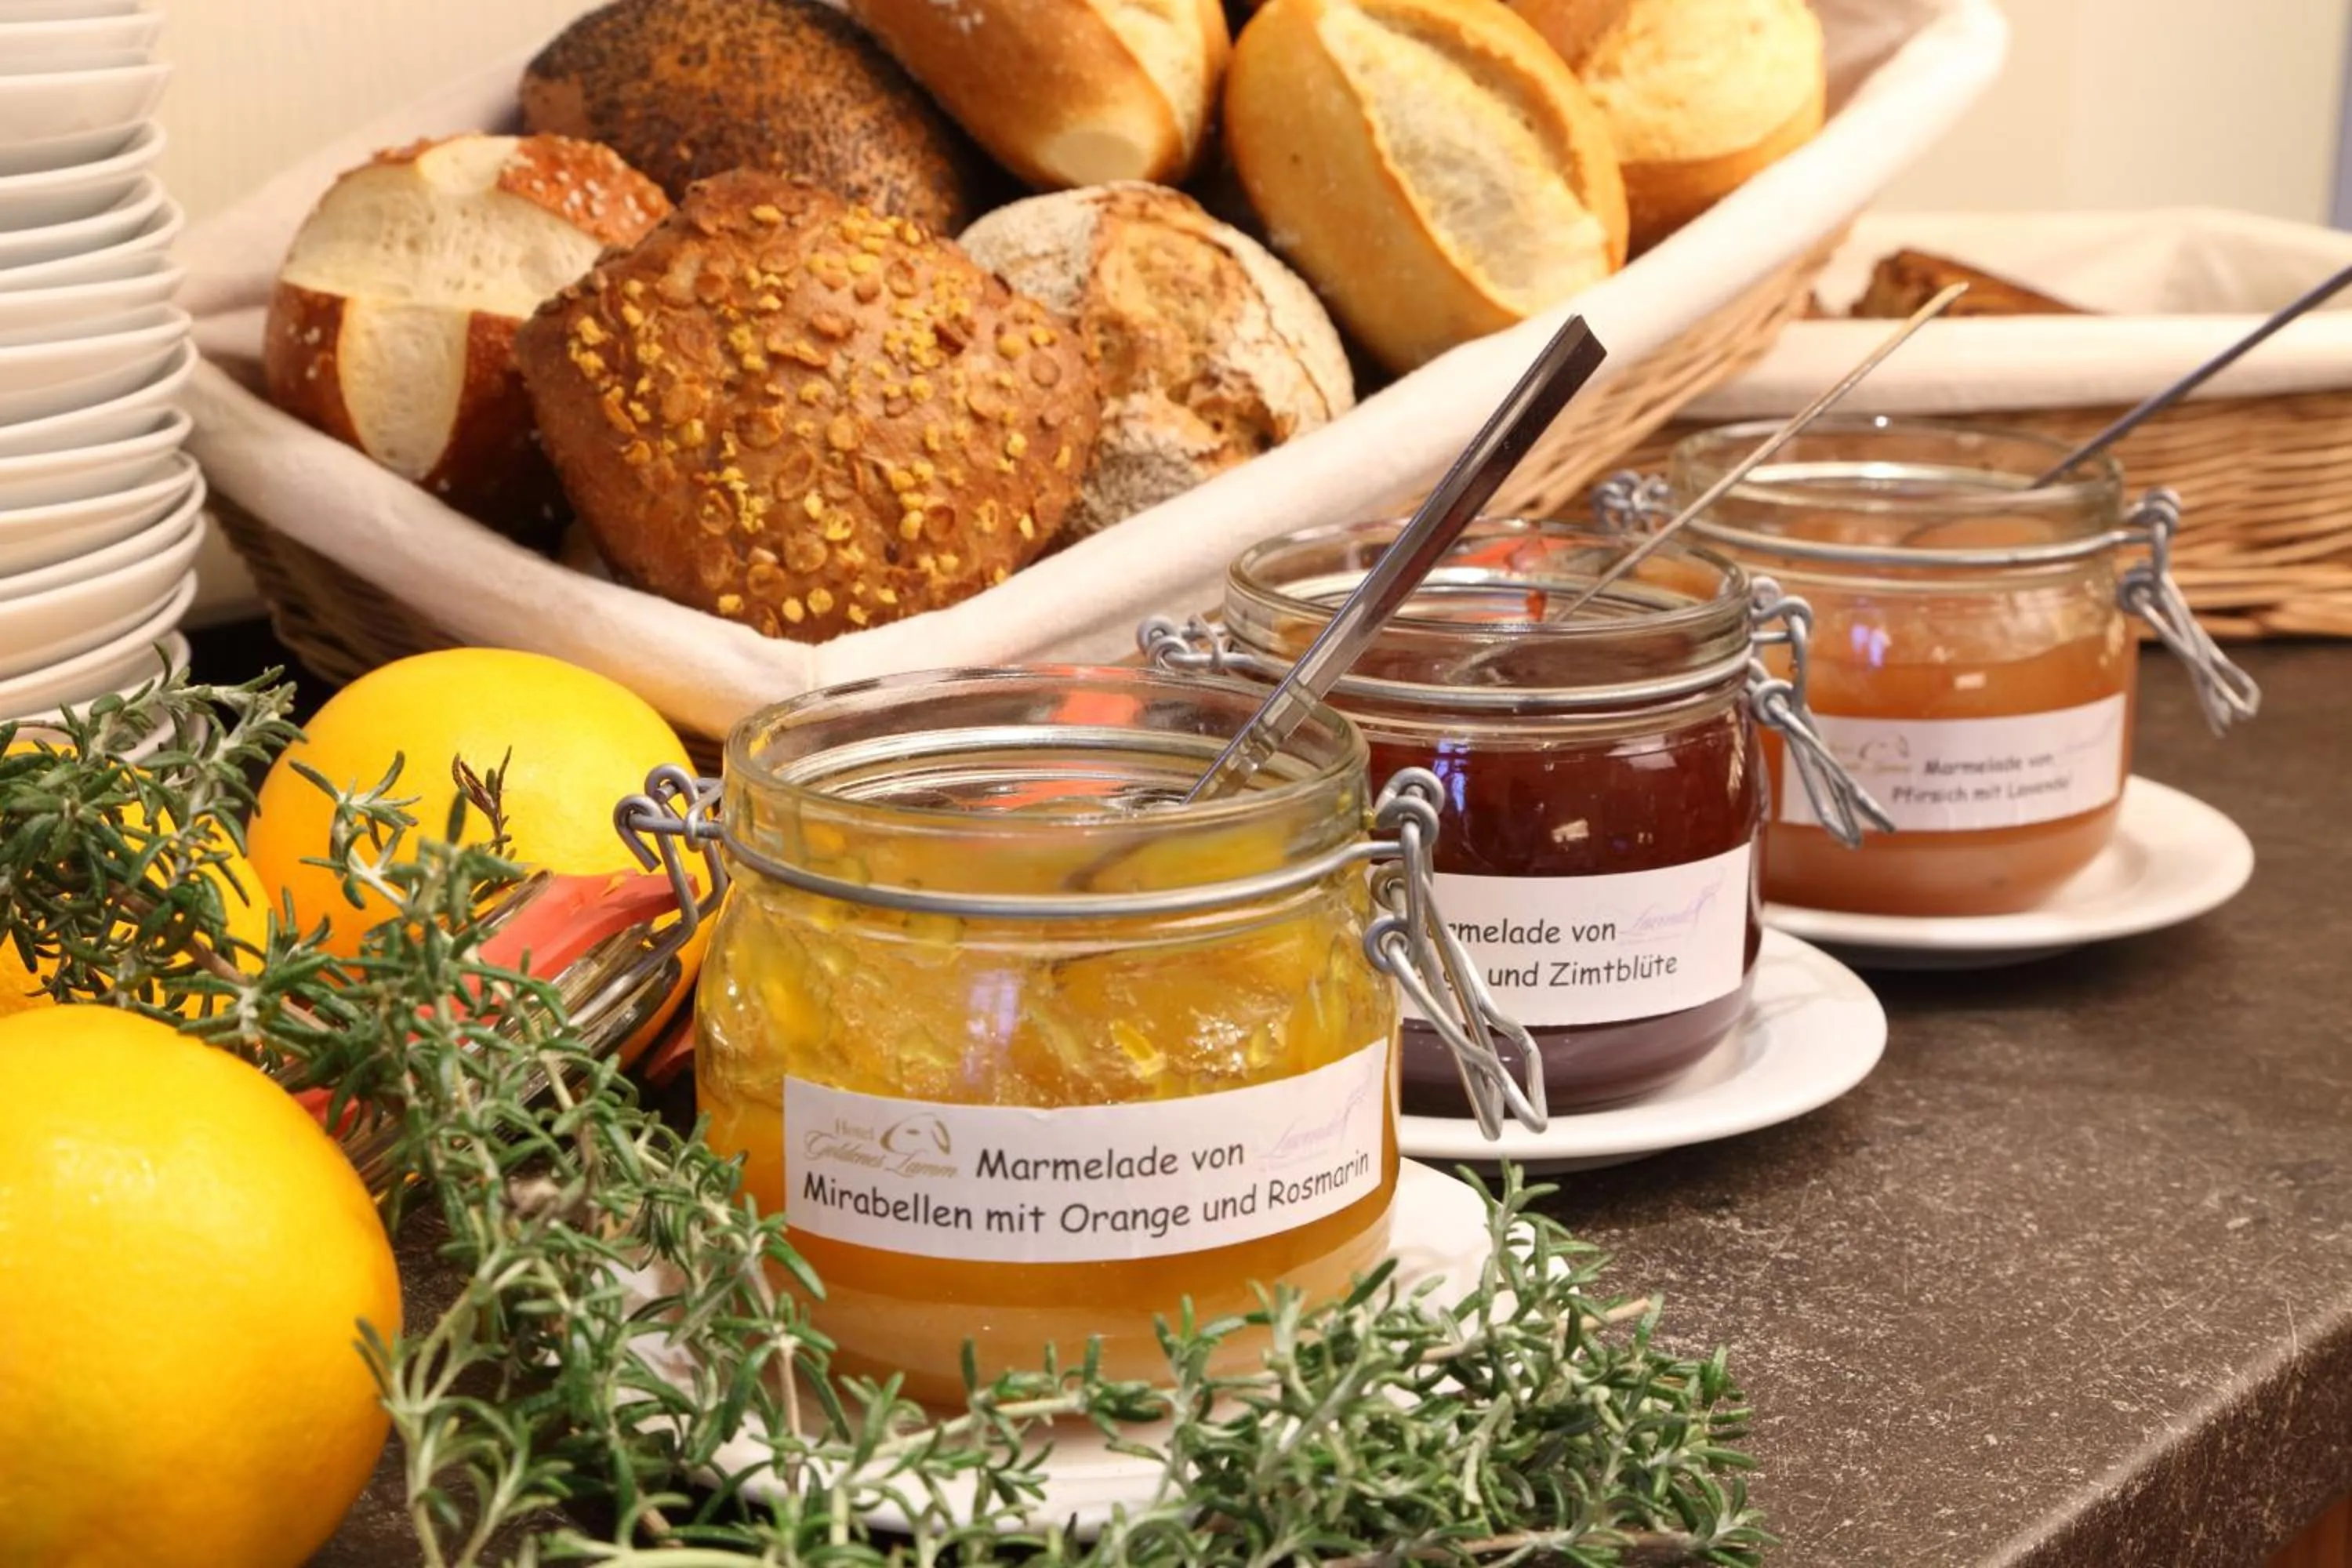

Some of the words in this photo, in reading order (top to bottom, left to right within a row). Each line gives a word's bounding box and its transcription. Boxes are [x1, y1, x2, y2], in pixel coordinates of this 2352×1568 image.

[1571, 922, 1616, 942] von
[1487, 960, 1539, 988] und
[1548, 953, 1678, 987] Zimtblüte
[975, 1145, 1179, 1181] Marmelade
[1191, 1142, 1244, 1171] von
[803, 1171, 973, 1231] Mirabellen
[986, 1203, 1047, 1234] mit
[1060, 1203, 1191, 1239] Orange
[1203, 1182, 1257, 1222] und
[1267, 1149, 1370, 1210] Rosmarin
